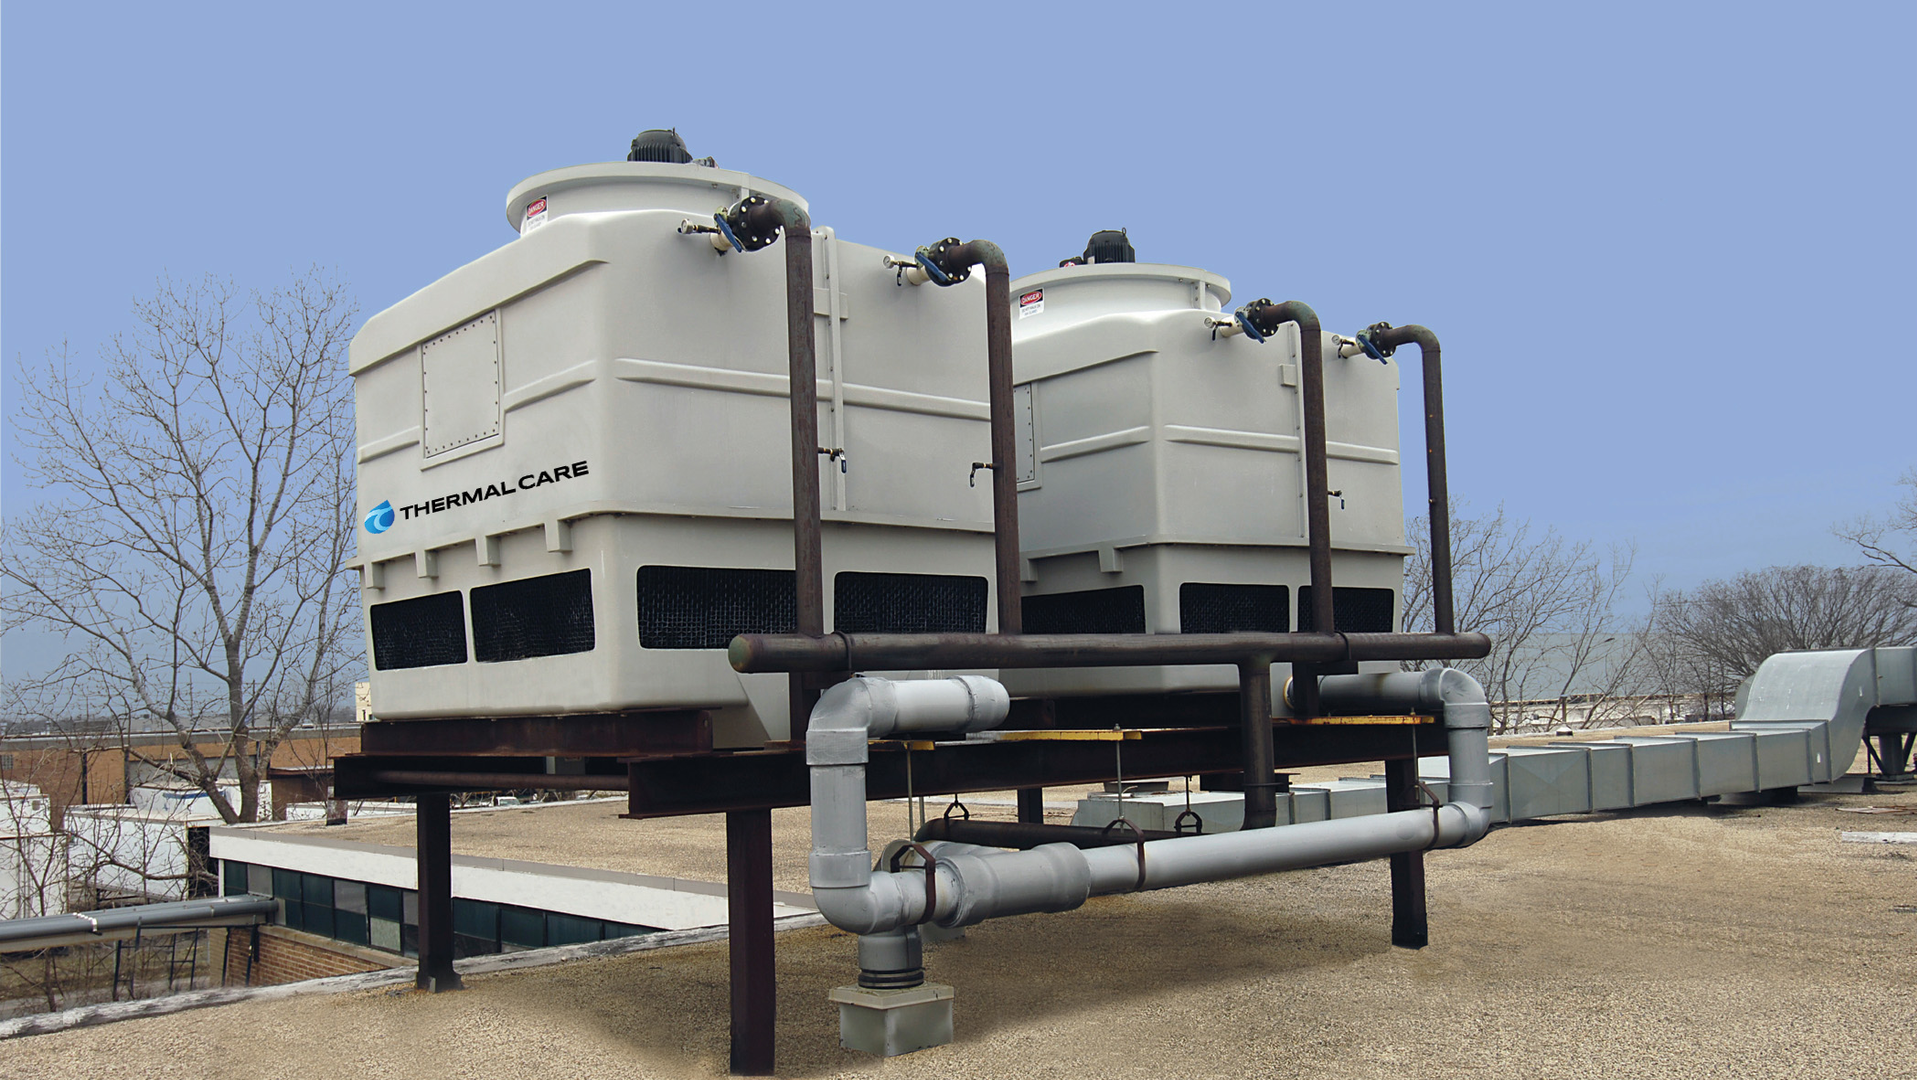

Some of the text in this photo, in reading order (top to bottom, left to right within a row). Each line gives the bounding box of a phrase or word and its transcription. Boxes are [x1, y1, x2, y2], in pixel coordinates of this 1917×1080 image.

[1022, 293, 1040, 303] DANGER
[399, 460, 589, 520] THERMAL CARE
